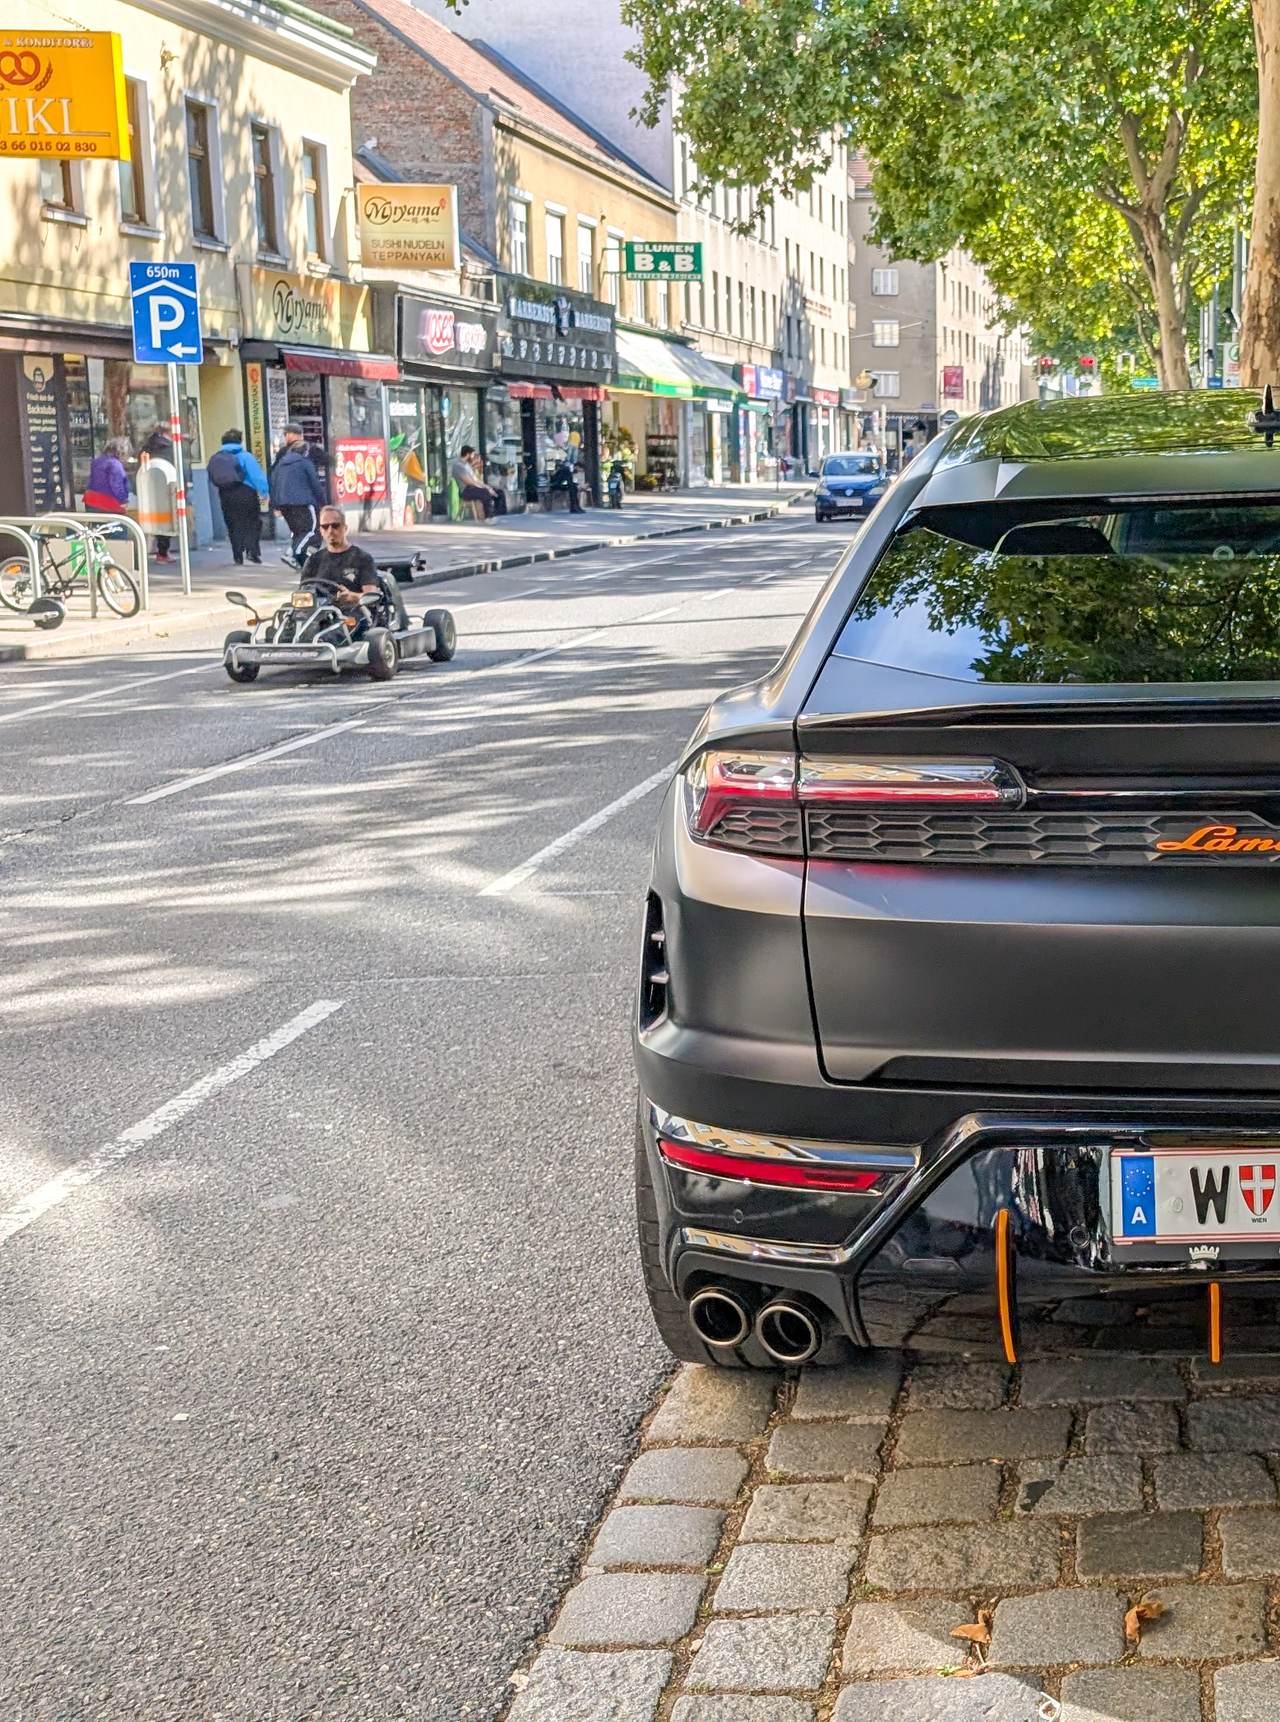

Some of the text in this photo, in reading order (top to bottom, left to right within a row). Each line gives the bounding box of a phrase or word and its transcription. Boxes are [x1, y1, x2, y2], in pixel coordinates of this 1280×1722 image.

[16, 37, 94, 49] KONDITOREI
[0, 97, 73, 136] IKI
[11, 141, 27, 151] 66
[30, 141, 53, 151] 015
[55, 142, 71, 152] 02
[74, 142, 97, 152] 830
[364, 196, 442, 225] Miyama
[371, 239, 445, 250] SUSHI NUDELN
[633, 244, 695, 254] BLUMEN
[371, 251, 446, 262] TEPPANYAKI
[634, 253, 695, 272] B & B
[146, 266, 180, 279] 650m
[149, 296, 185, 349] P
[1189, 1165, 1231, 1225] W
[1131, 1206, 1148, 1224] A
